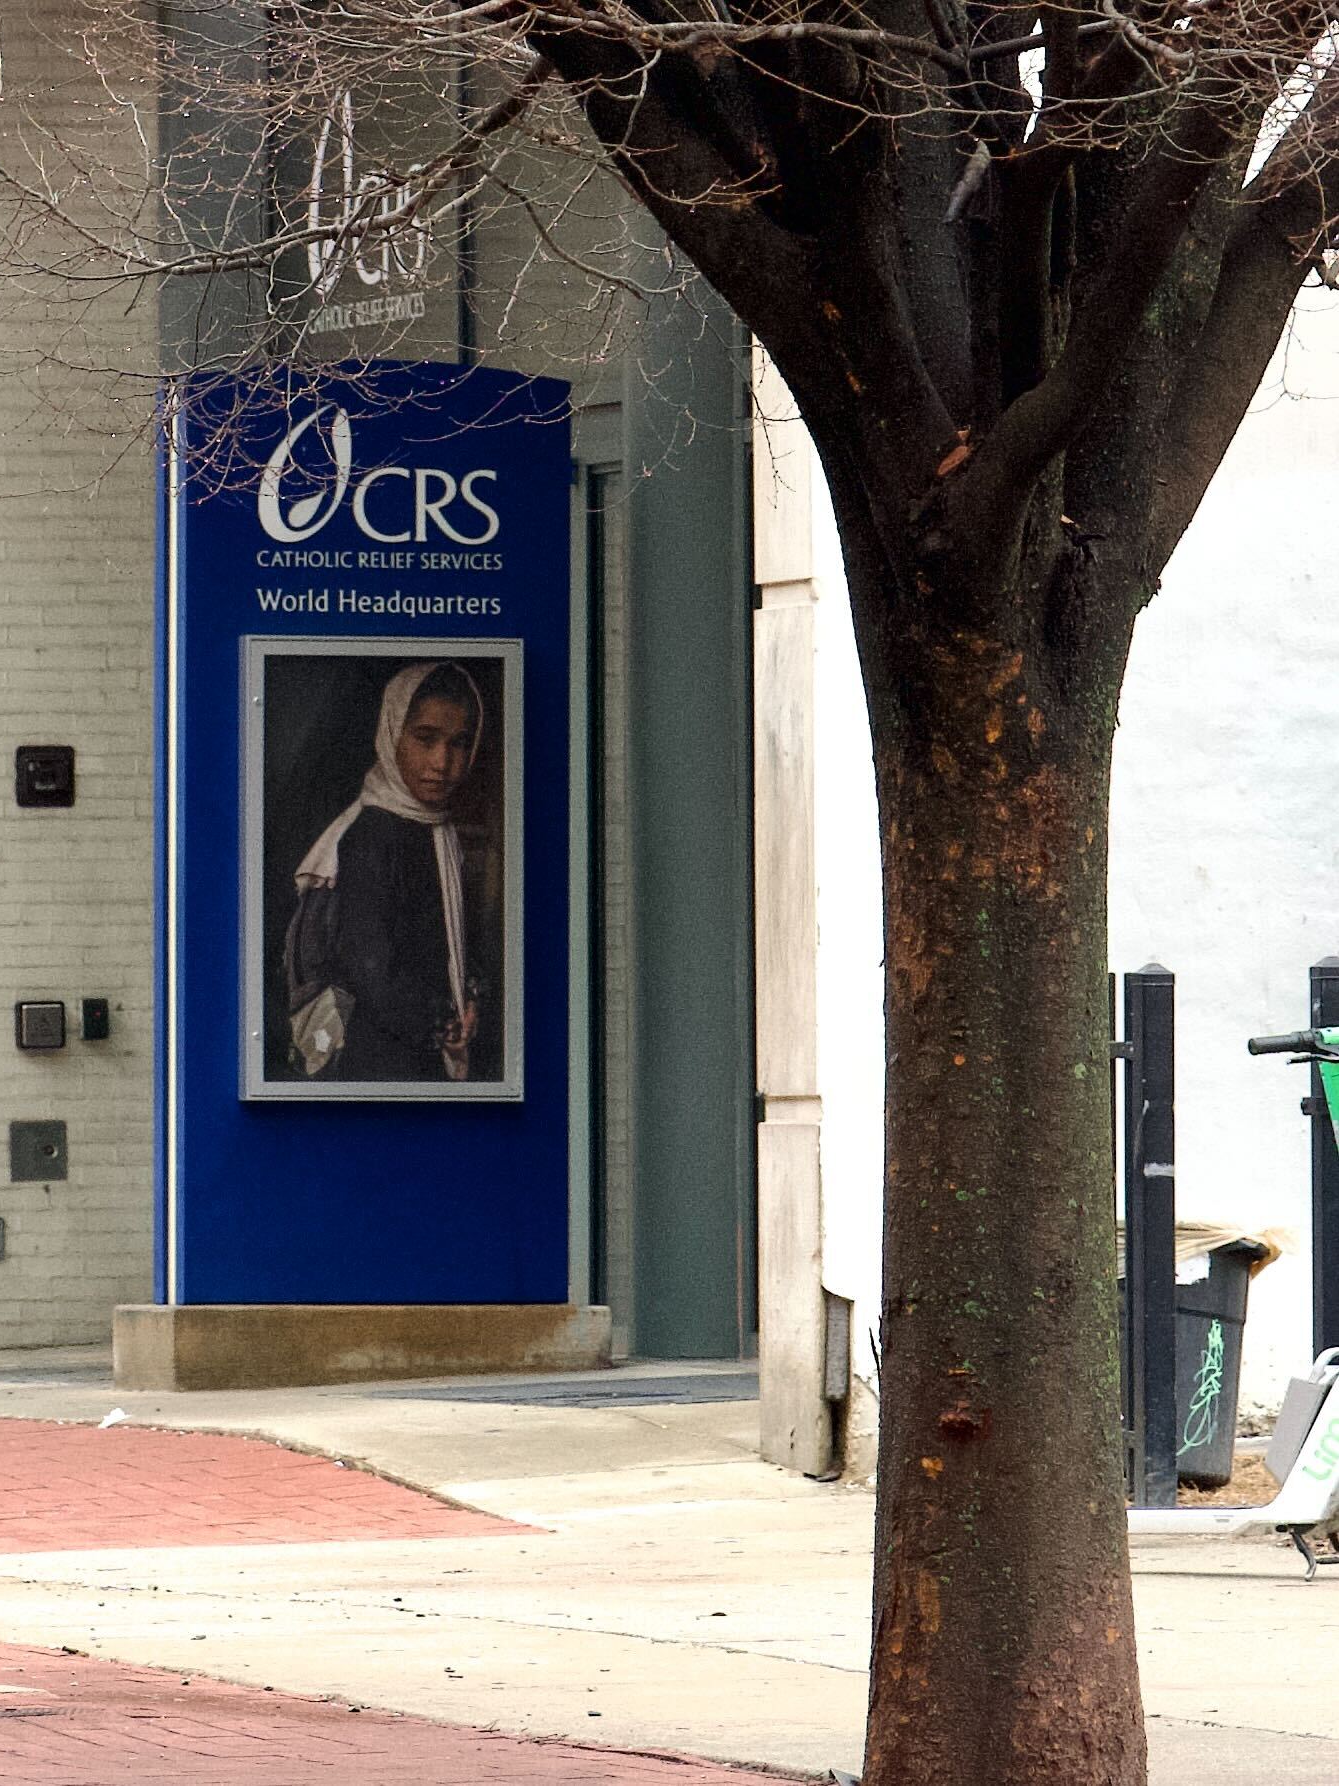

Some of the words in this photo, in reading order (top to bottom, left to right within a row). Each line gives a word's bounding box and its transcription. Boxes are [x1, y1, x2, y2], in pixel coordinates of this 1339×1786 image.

[353, 466, 500, 546] CRS
[256, 550, 353, 569] CATHOLIC
[358, 551, 415, 570] RELIEF
[420, 552, 503, 571] SERVICES
[256, 588, 329, 613] World
[339, 588, 502, 618] Headquarters
